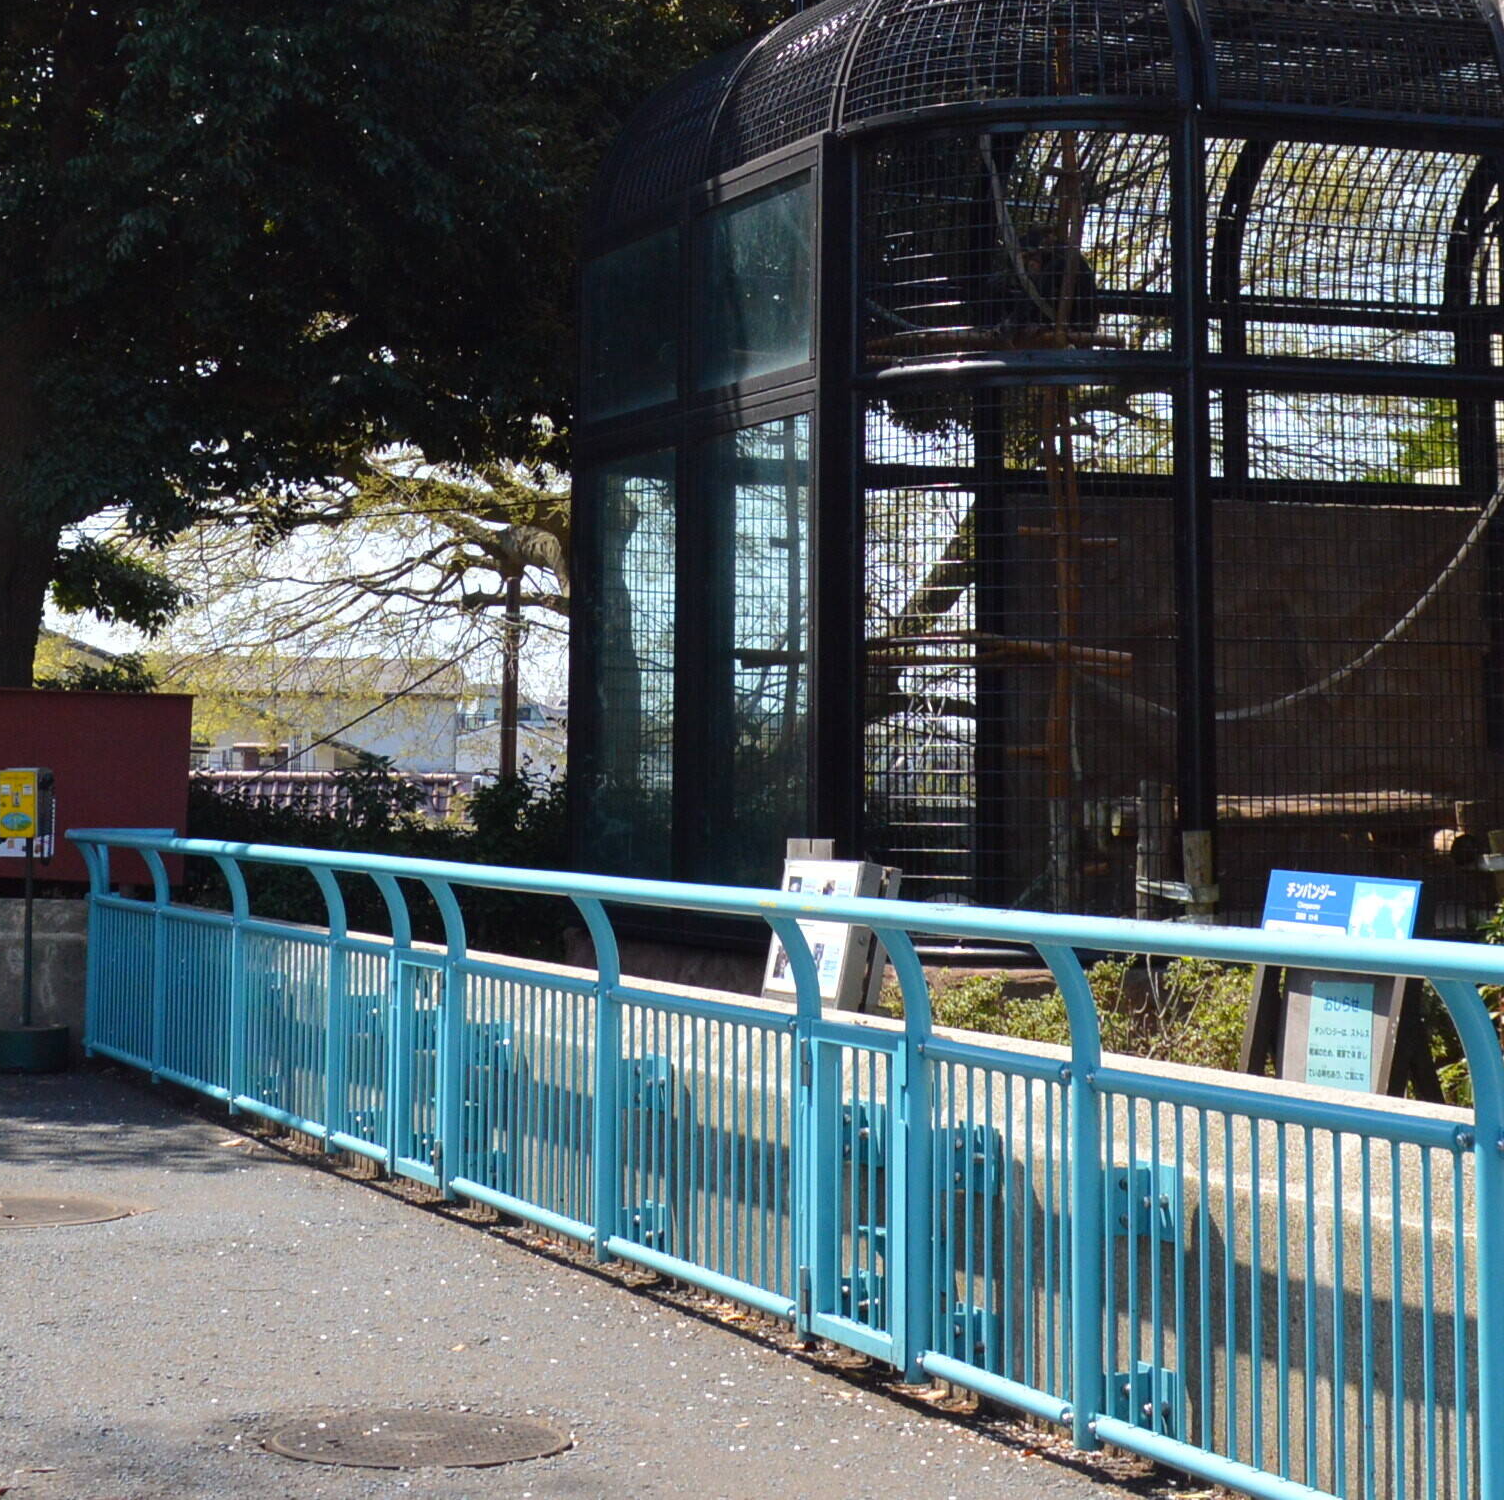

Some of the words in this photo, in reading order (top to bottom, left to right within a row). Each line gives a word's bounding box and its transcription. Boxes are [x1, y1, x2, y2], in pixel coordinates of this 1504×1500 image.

[1286, 882, 1337, 900] チンパンジー
[1323, 995, 1360, 1013] おしらせ
